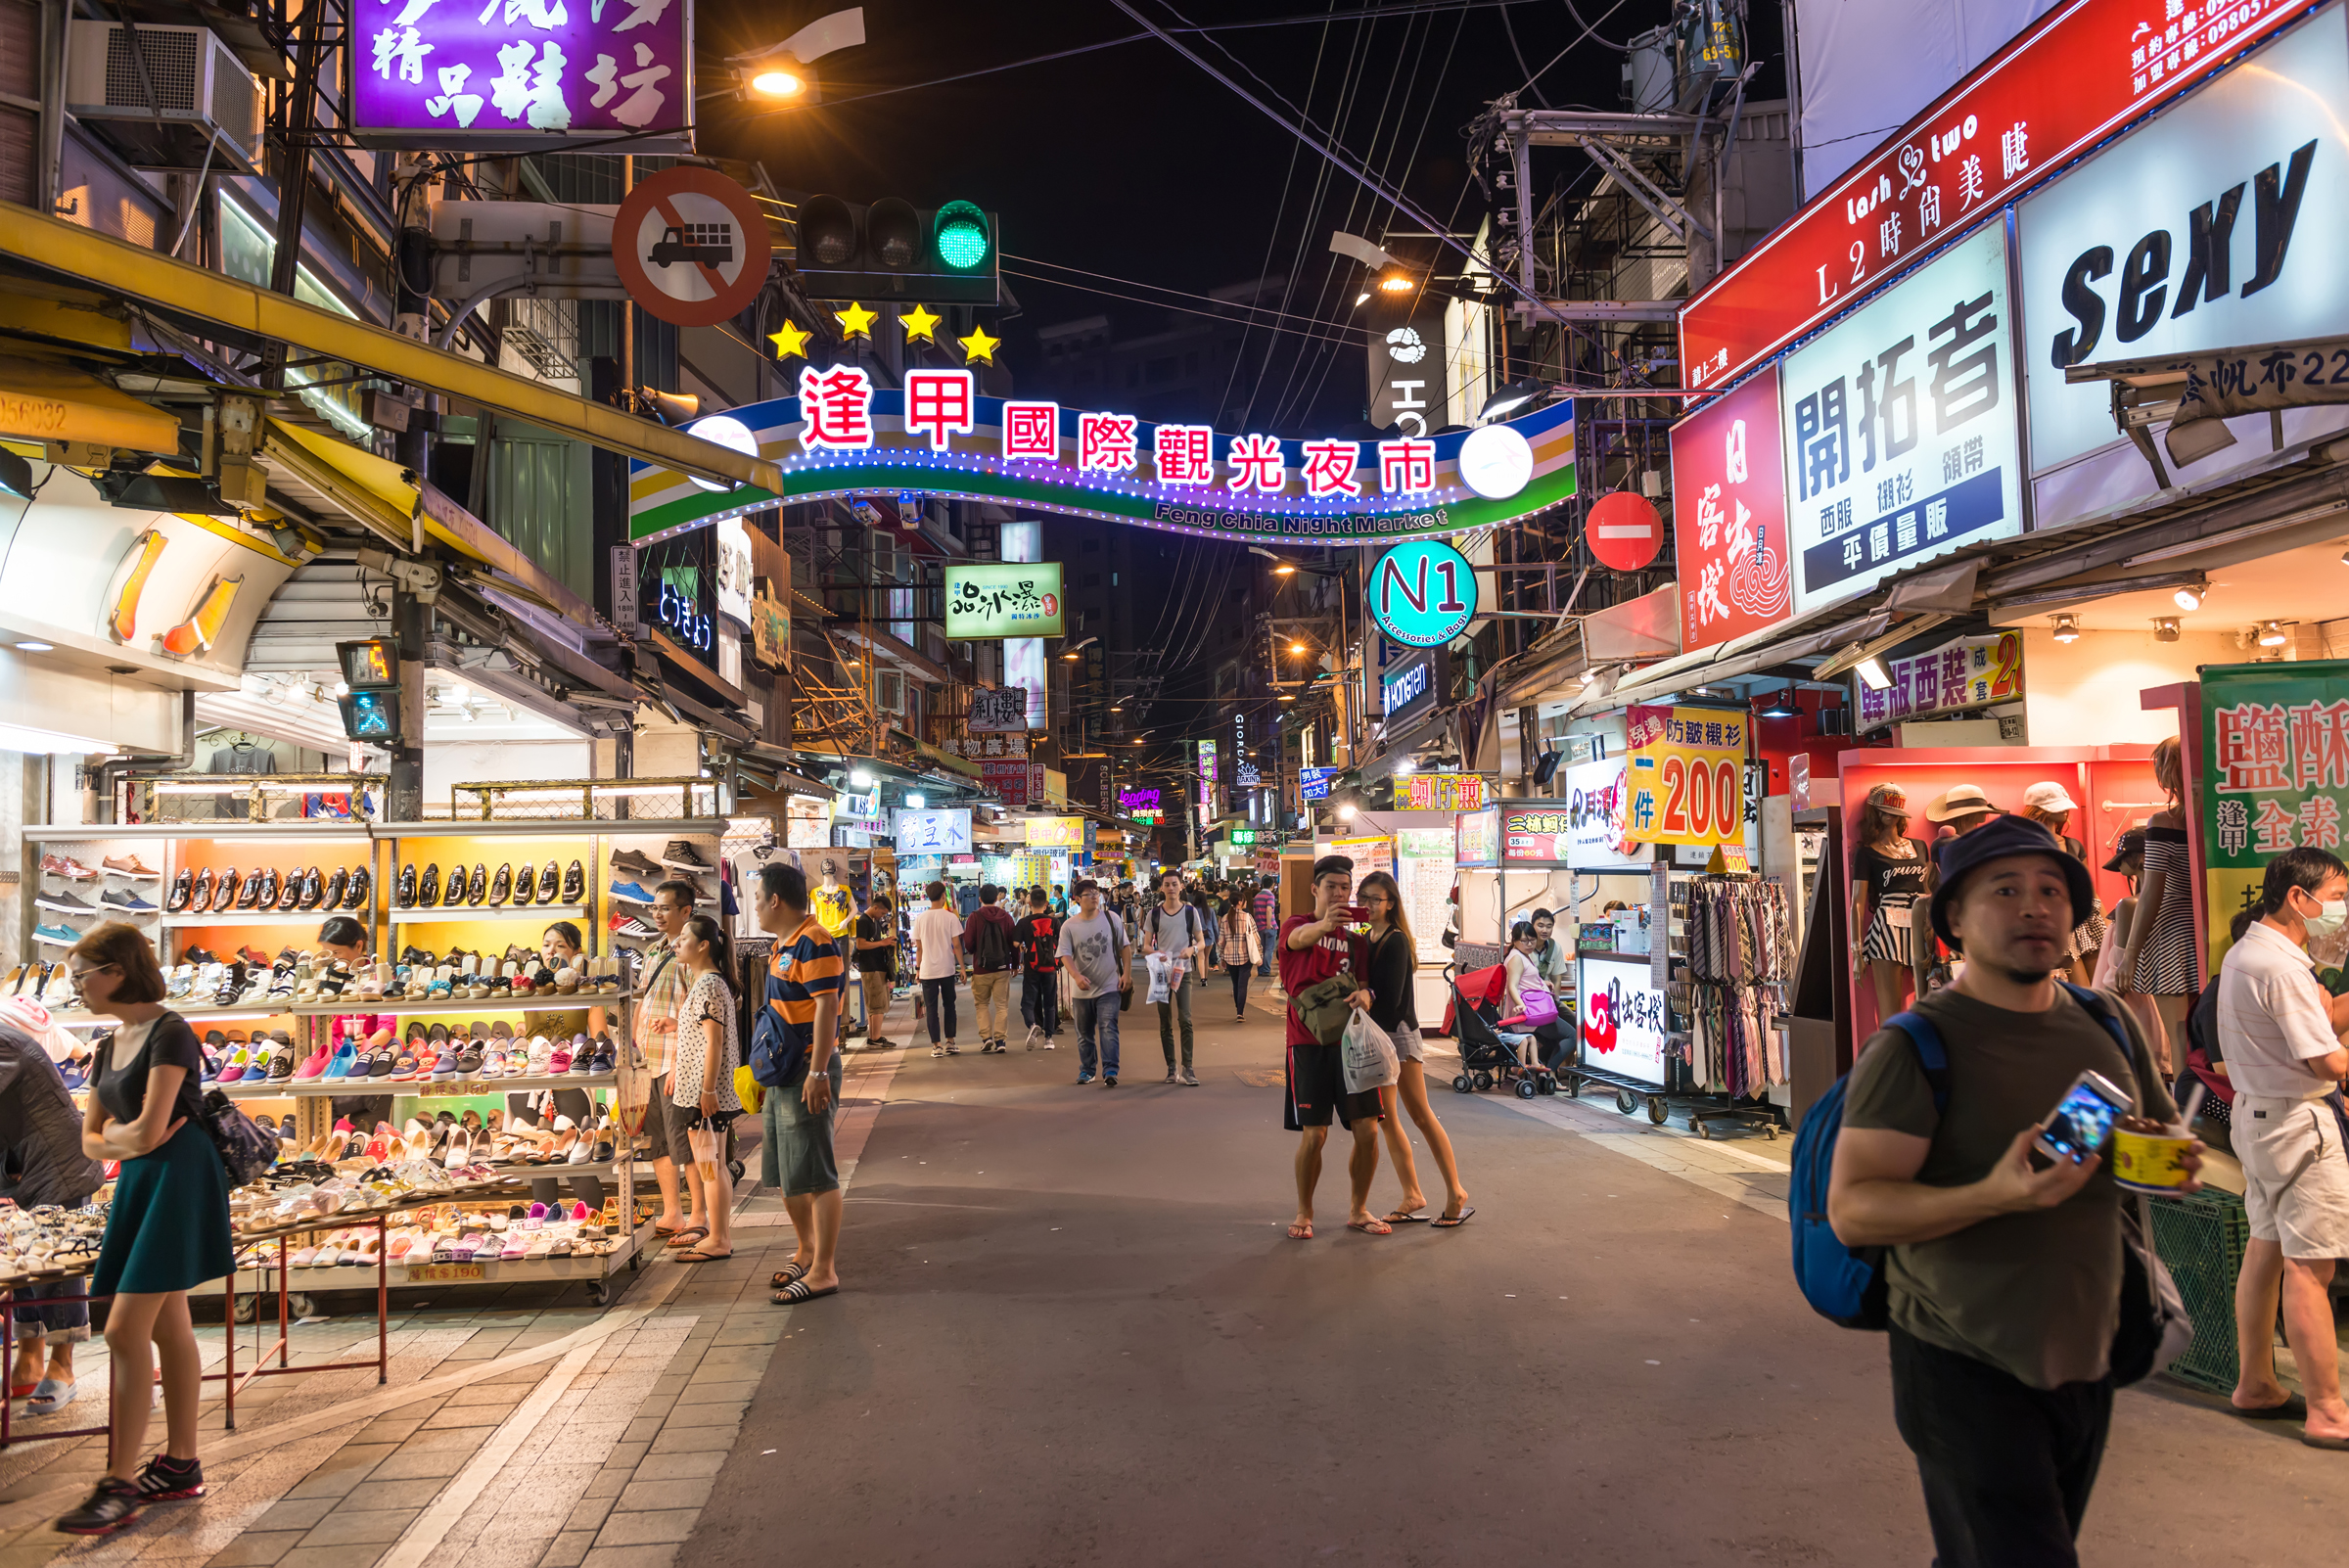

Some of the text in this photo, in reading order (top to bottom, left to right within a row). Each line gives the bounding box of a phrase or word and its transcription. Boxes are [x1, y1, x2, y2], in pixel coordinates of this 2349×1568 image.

[1712, 22, 1733, 33] TPC
[1847, 115, 1978, 225] lash two
[1795, 290, 2001, 503] 開拓者
[799, 363, 1437, 497] 逢甲國際觀光夜市
[1819, 435, 1984, 537] 西服 襯衫 領帶
[1155, 502, 1450, 535] Feng Chia Night Market
[1842, 496, 1949, 571] 平價量販
[618, 549, 632, 603] 禁止進入
[1380, 554, 1467, 615] N1
[1381, 616, 1437, 644] Accessories
[1445, 613, 1468, 636] Bags
[1973, 646, 1988, 702] 成套
[1991, 633, 2023, 700] 2
[1235, 714, 1245, 767] GIORDA
[1629, 715, 1742, 748] 免燙 防皺襯衫
[979, 762, 1026, 775] 樓柑仔店
[1409, 776, 1481, 809] 蚵仔煎
[1634, 756, 1655, 831] 一件
[1662, 755, 1737, 840] 200
[2252, 795, 2349, 853] 全素
[2218, 800, 2248, 856] 逢甲
[1727, 855, 1747, 872] 100
